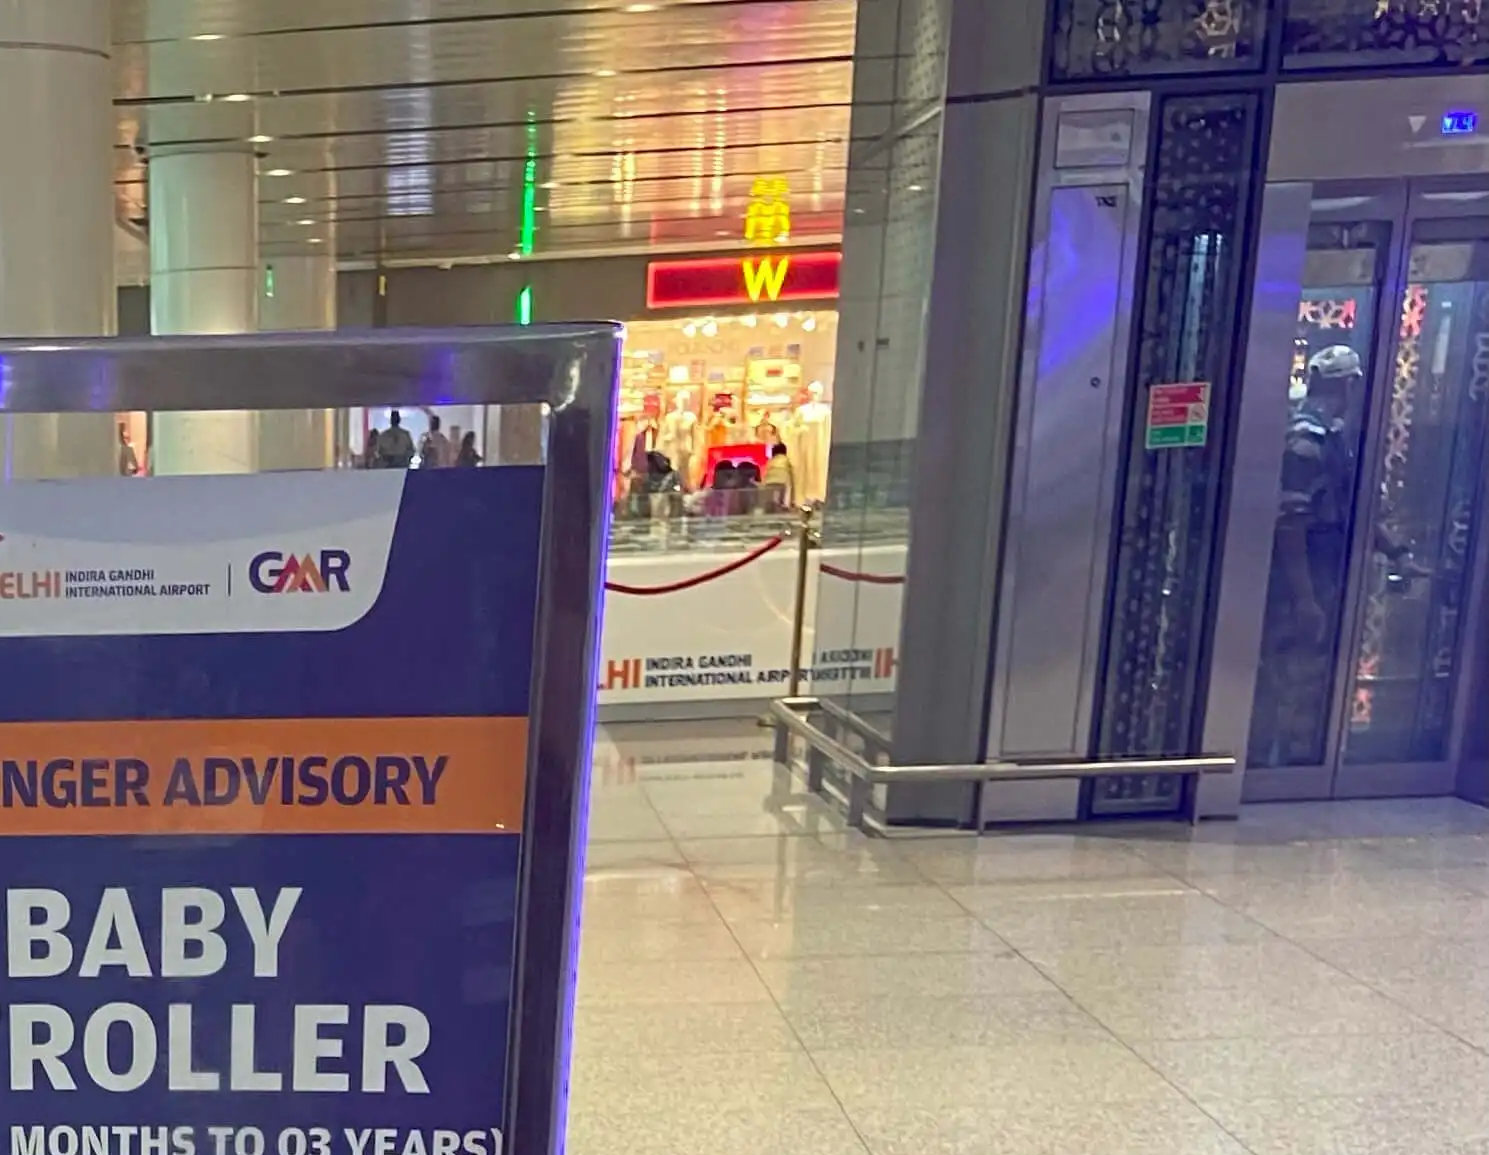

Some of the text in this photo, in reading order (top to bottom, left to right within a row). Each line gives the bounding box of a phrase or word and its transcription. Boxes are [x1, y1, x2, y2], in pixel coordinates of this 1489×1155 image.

[742, 256, 789, 302] W
[65, 569, 155, 583] INDIRA GANDHI
[248, 549, 352, 593] GMR
[65, 583, 211, 597] INTERNATIONAL AIRPORT
[644, 671, 752, 688] INTERNATIONAL
[756, 668, 814, 683] AIRPRT
[645, 653, 752, 671] INDIRA GANDHI
[162, 756, 449, 807] ADVISORY
[6, 887, 303, 978] BABY
